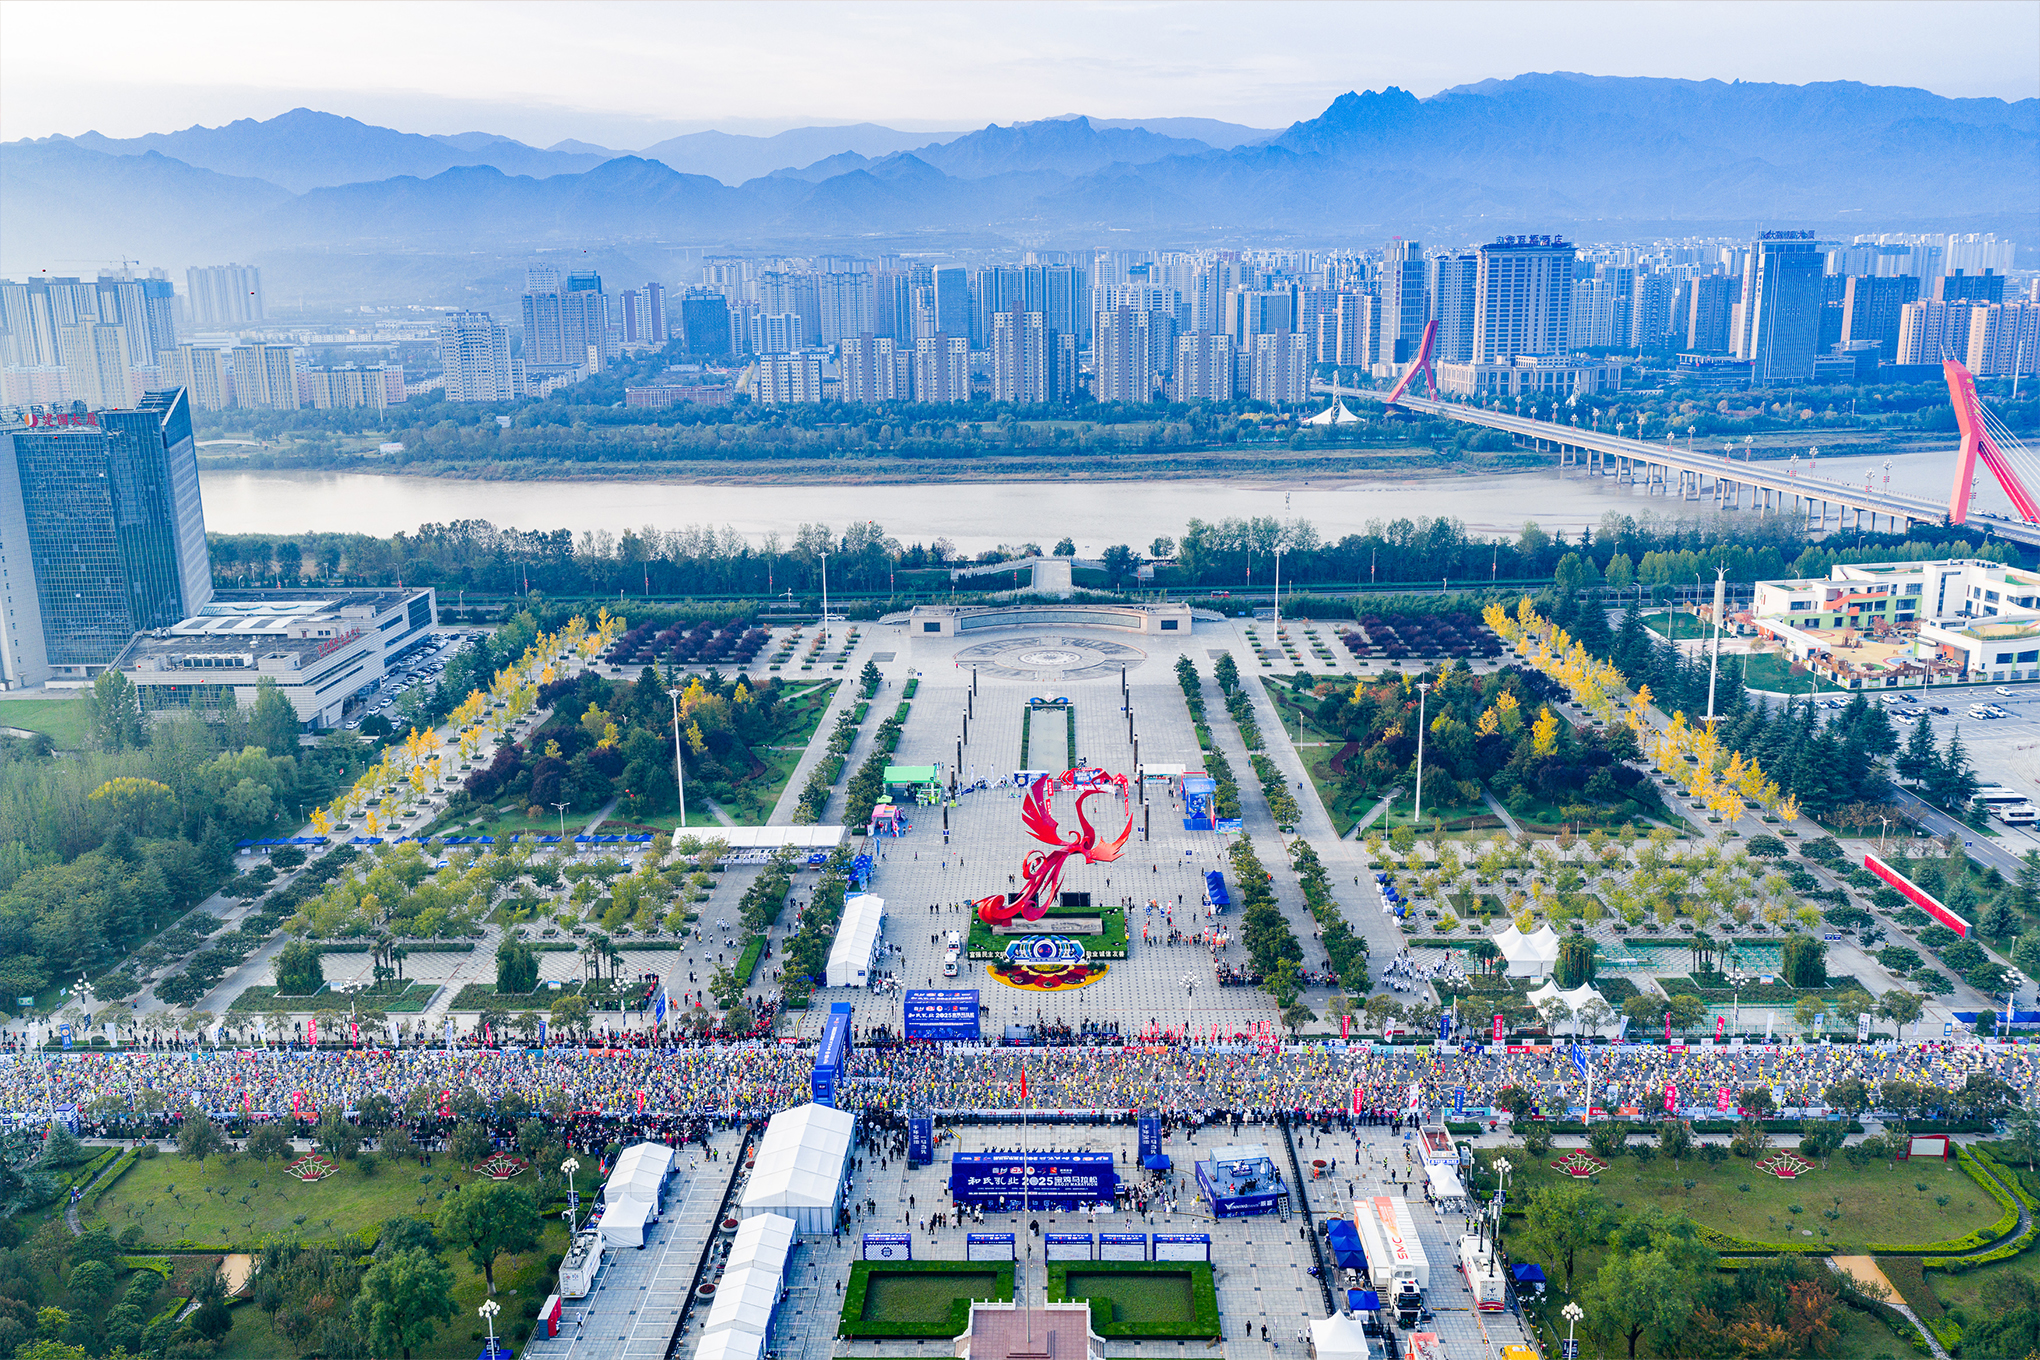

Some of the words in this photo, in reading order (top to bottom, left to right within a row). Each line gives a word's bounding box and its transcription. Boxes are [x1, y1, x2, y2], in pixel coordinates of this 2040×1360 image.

[967, 1176, 1019, 1186] 和氏乳业
[1021, 1176, 1054, 1186] 2025
[1391, 1236, 1409, 1260] SMC
